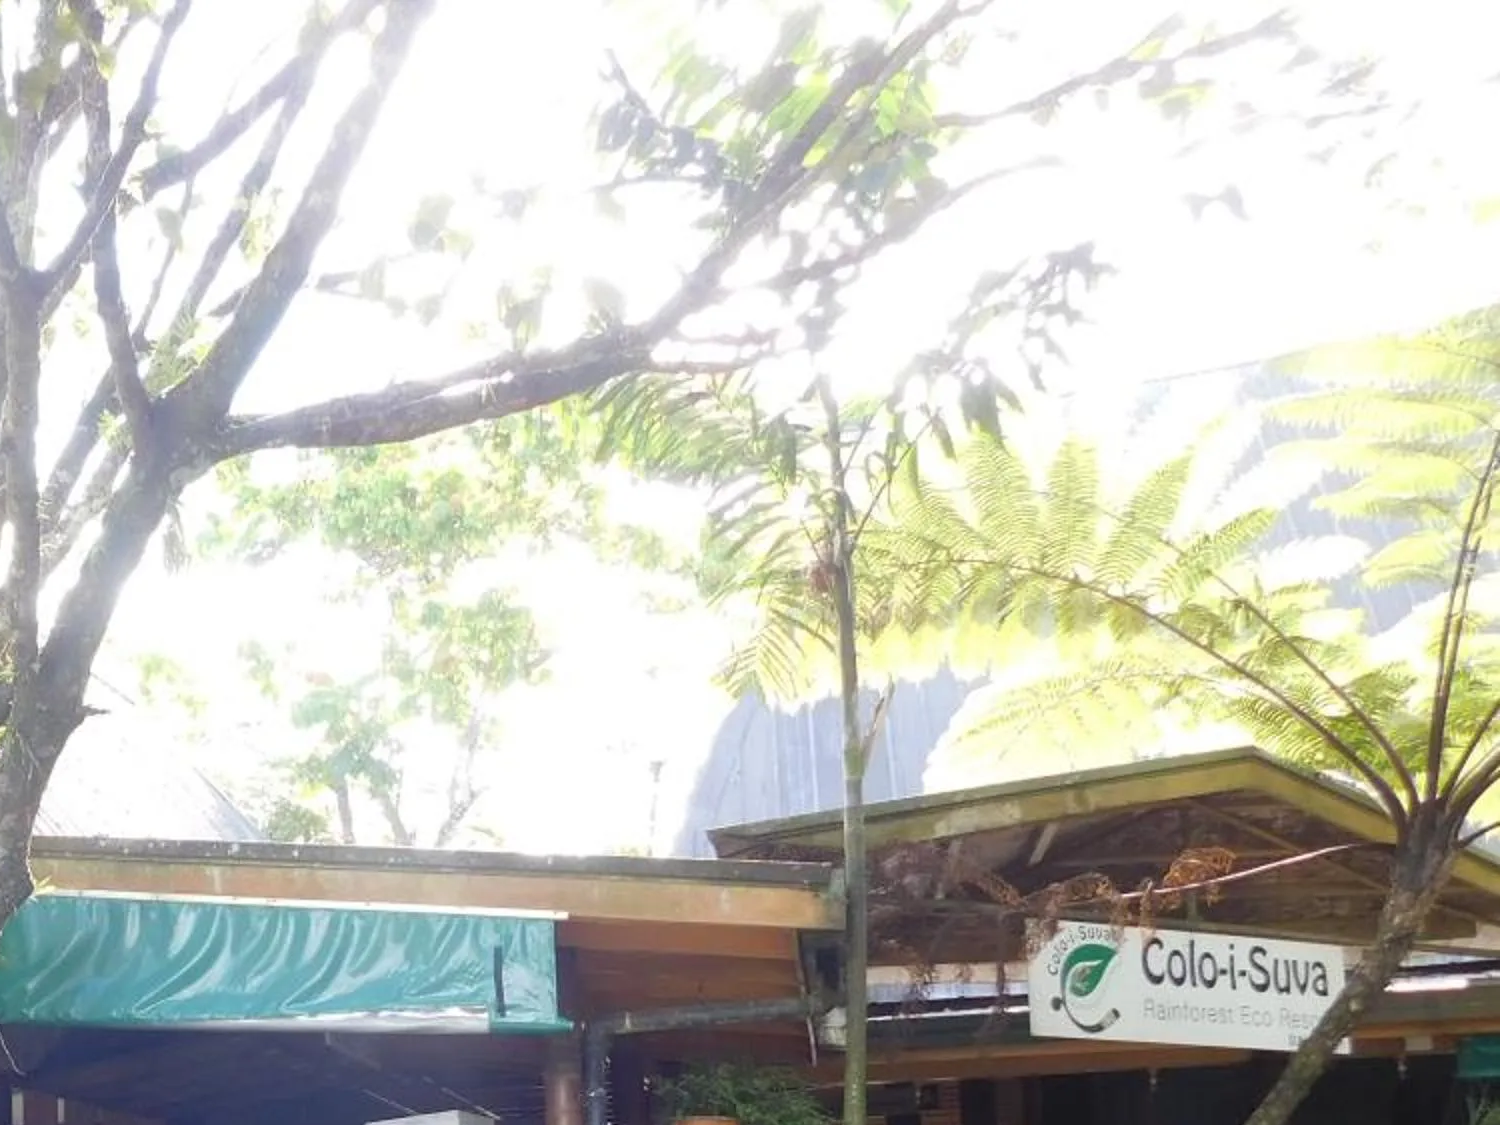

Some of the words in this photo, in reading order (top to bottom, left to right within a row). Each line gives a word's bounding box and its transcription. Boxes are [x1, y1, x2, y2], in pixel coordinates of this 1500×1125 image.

[1141, 936, 1329, 996] Colo-i-Suva
[1143, 999, 1235, 1025] Rainforest
[1239, 1005, 1272, 1028] Eco
